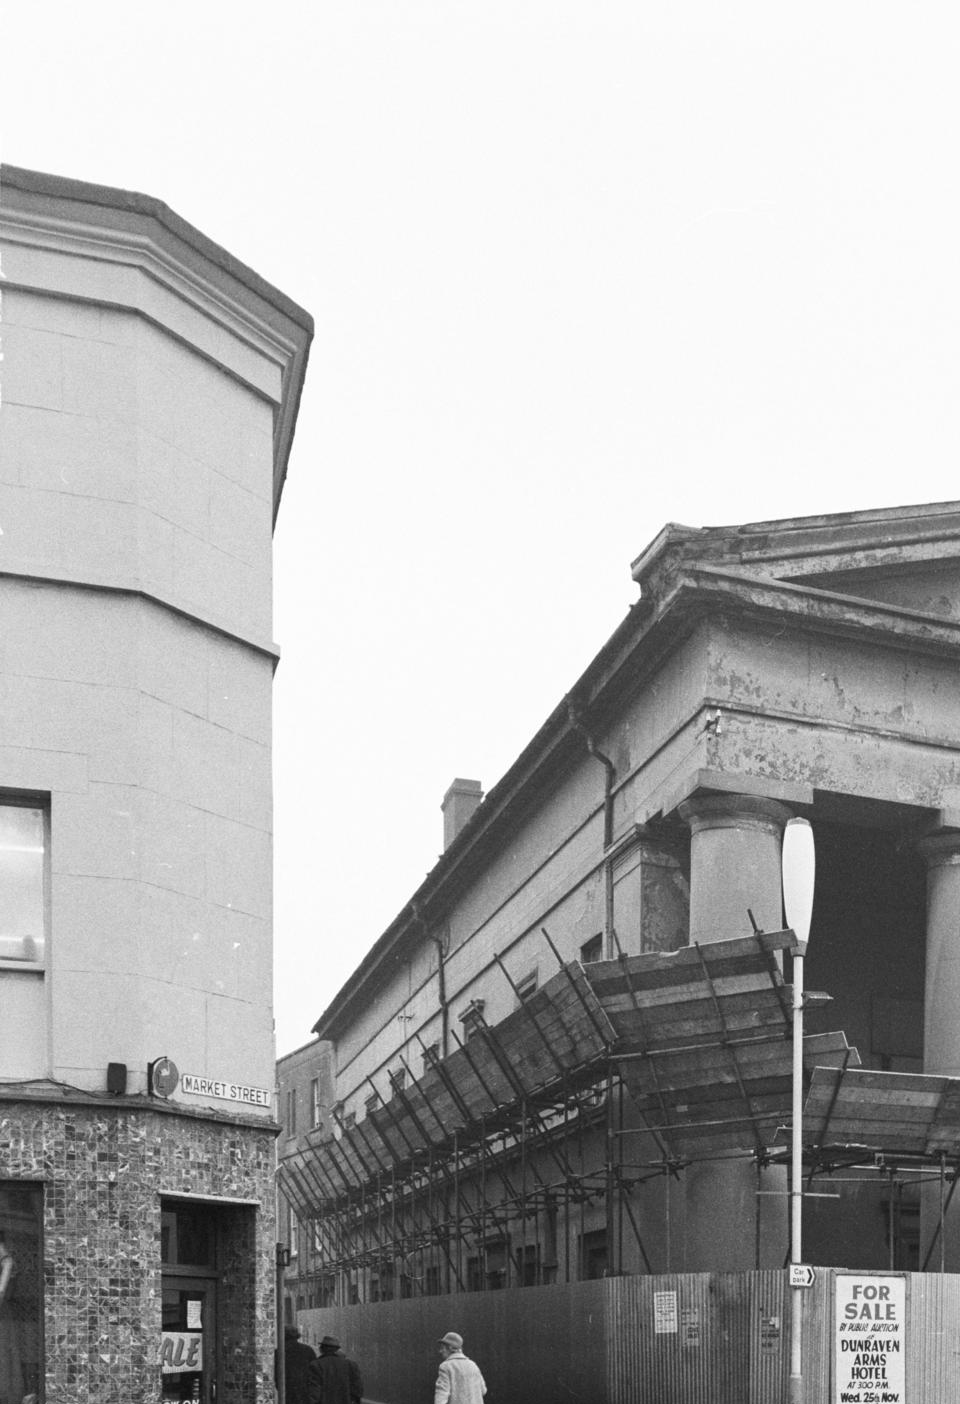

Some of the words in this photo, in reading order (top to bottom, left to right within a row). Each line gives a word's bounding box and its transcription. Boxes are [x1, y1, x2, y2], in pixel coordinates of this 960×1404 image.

[185, 1077, 227, 1096] MARKET
[230, 1085, 268, 1105] STREET
[852, 1285, 890, 1301] FOR
[844, 1302, 896, 1321] SALE
[839, 1322, 847, 1332] BY
[847, 1322, 869, 1332] PUBLIC
[870, 1323, 900, 1333] AUCTION
[161, 1337, 201, 1368] ALE
[841, 1339, 900, 1352] DUNRAVEN
[853, 1353, 887, 1366] ARMS
[851, 1366, 888, 1380] HOTEL
[847, 1381, 857, 1389] AT
